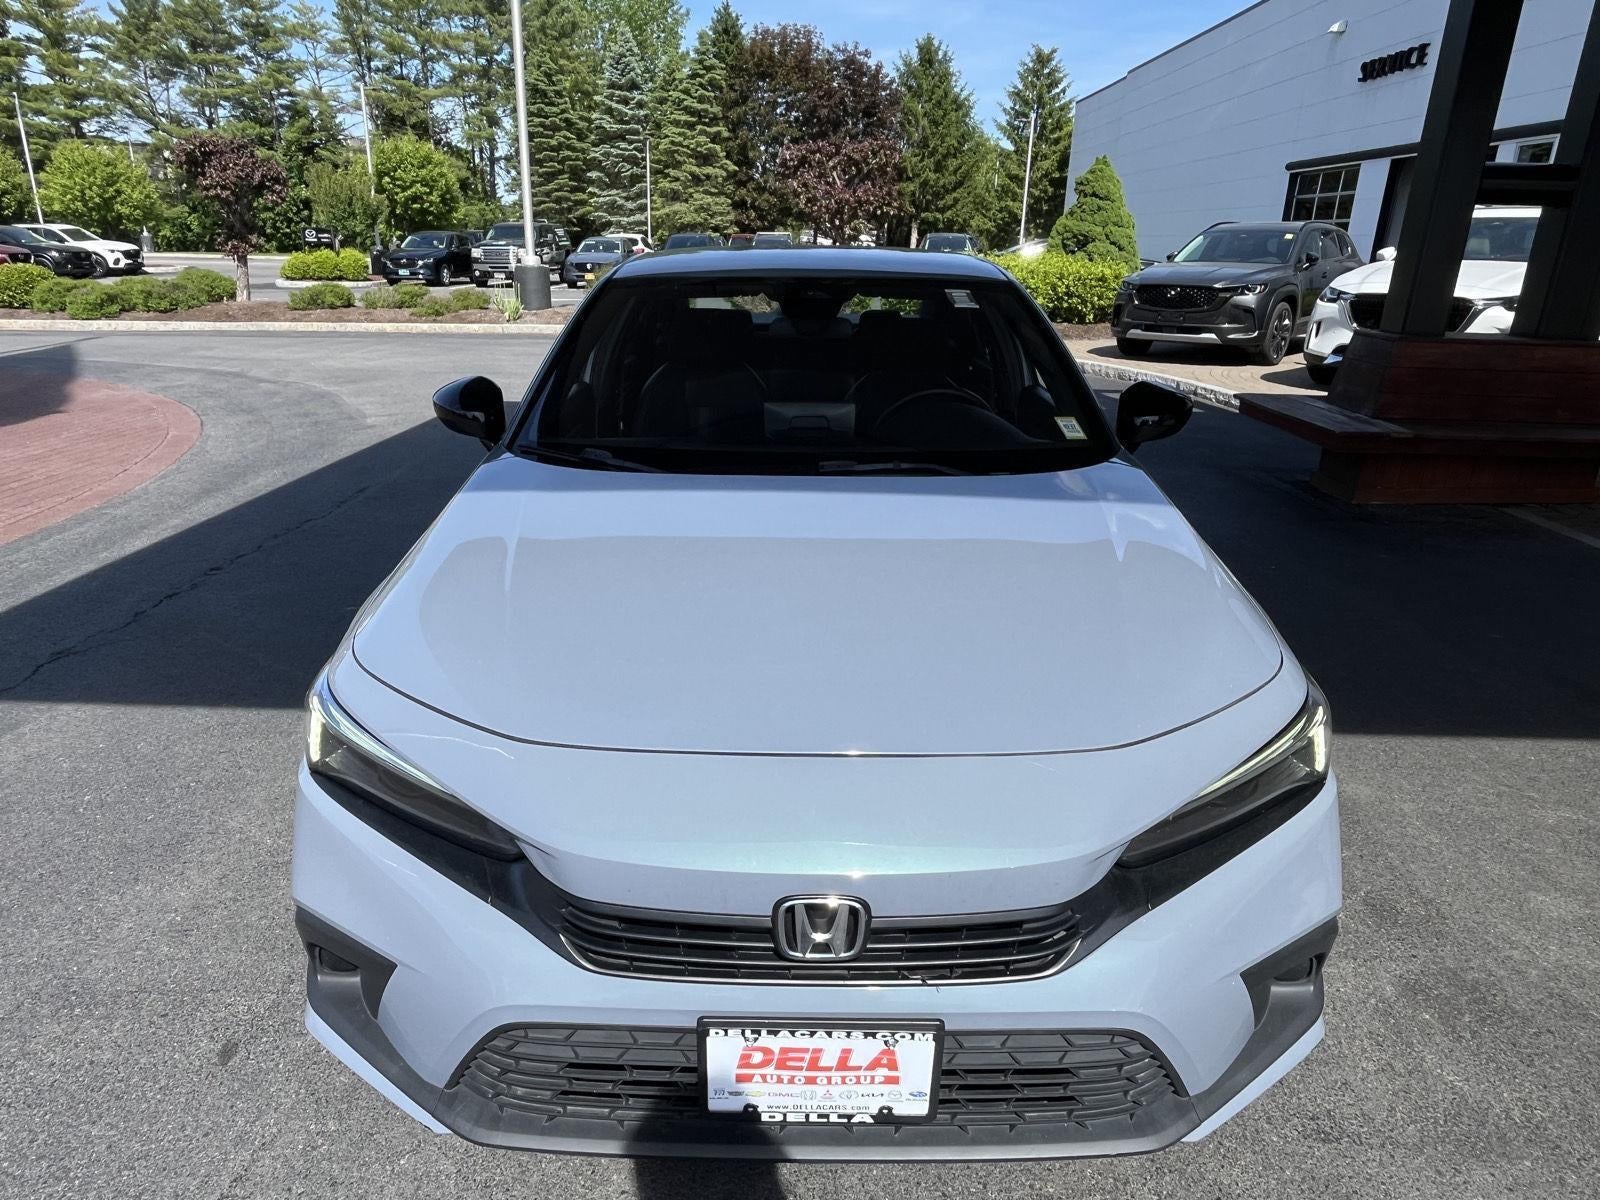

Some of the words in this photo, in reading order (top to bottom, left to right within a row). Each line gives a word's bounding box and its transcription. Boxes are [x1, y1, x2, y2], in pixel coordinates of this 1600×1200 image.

[1358, 43, 1431, 82] SERVICE
[709, 1029, 934, 1042] DELLACARS.COM
[736, 1046, 899, 1072] DELLA
[751, 1073, 806, 1084] AUTO
[816, 1075, 885, 1085] GROUP
[761, 1112, 875, 1123] DELLA
